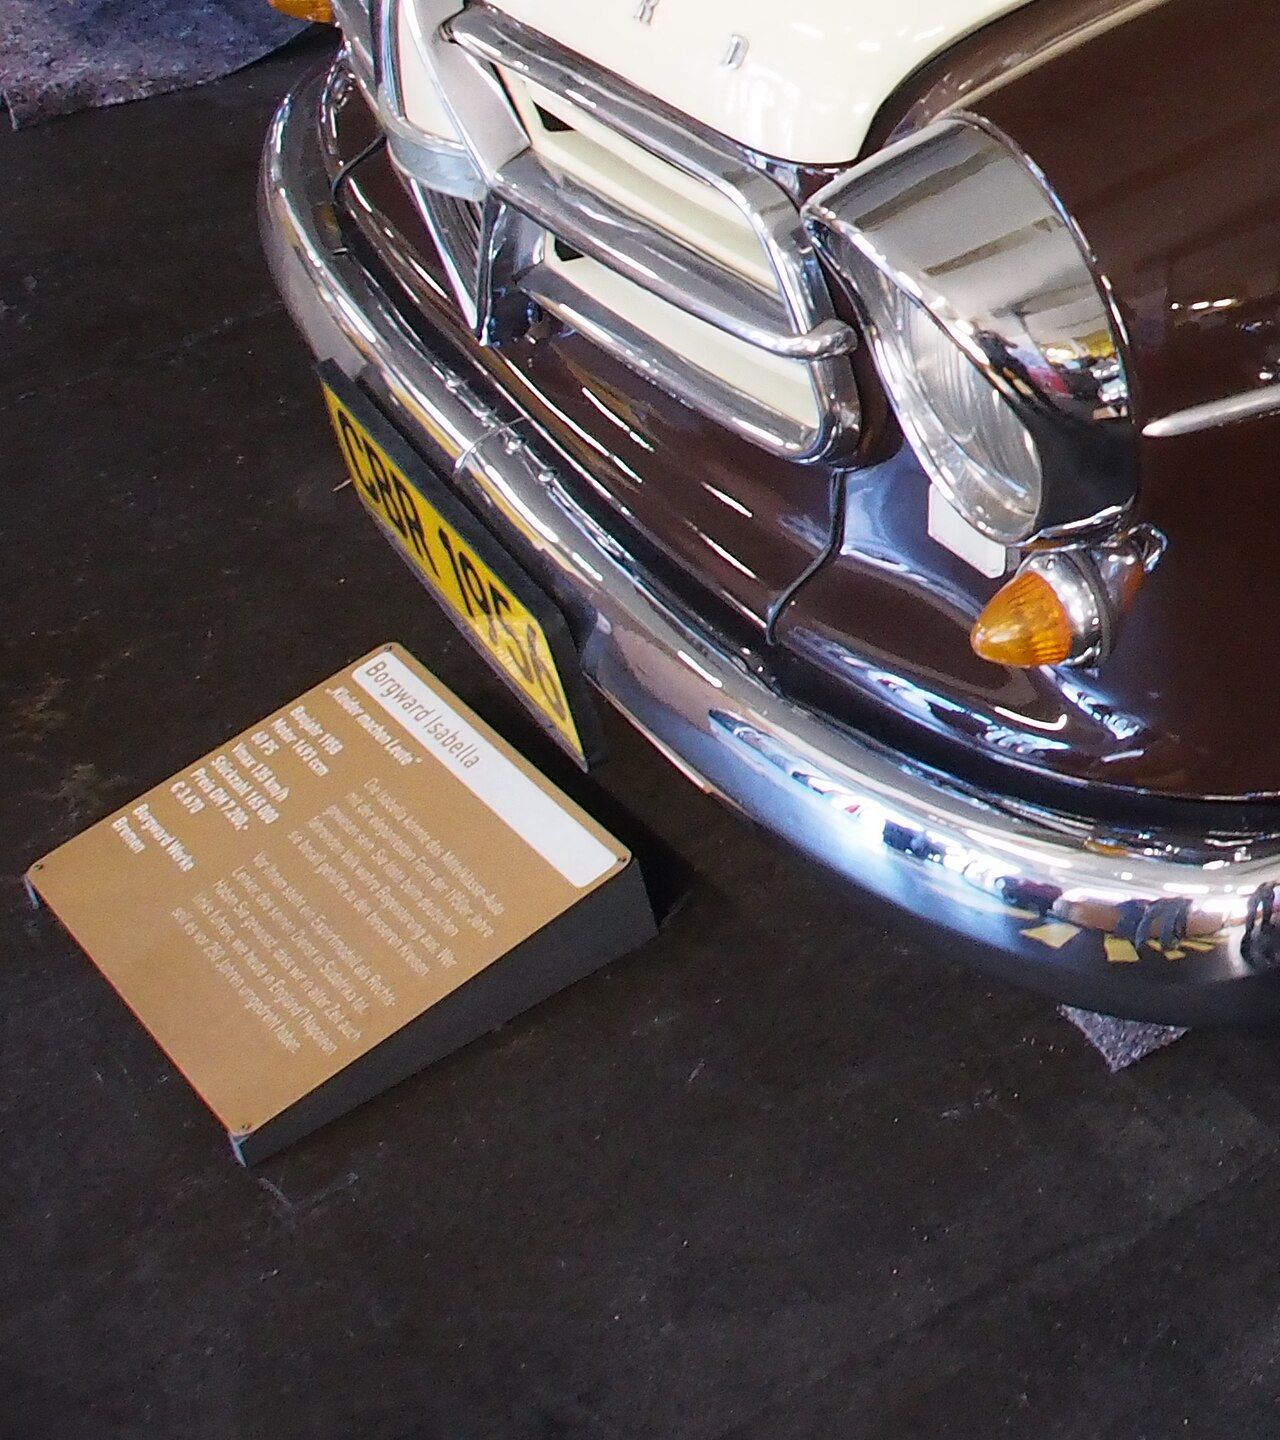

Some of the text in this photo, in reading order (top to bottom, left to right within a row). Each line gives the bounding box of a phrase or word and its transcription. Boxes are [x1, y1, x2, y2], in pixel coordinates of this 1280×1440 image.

[337, 408, 440, 580] CBR
[258, 738, 281, 757] PS
[364, 660, 480, 769] Borgward Isabella
[110, 815, 146, 855] Bremen
[131, 802, 195, 873] Borgward Werke
